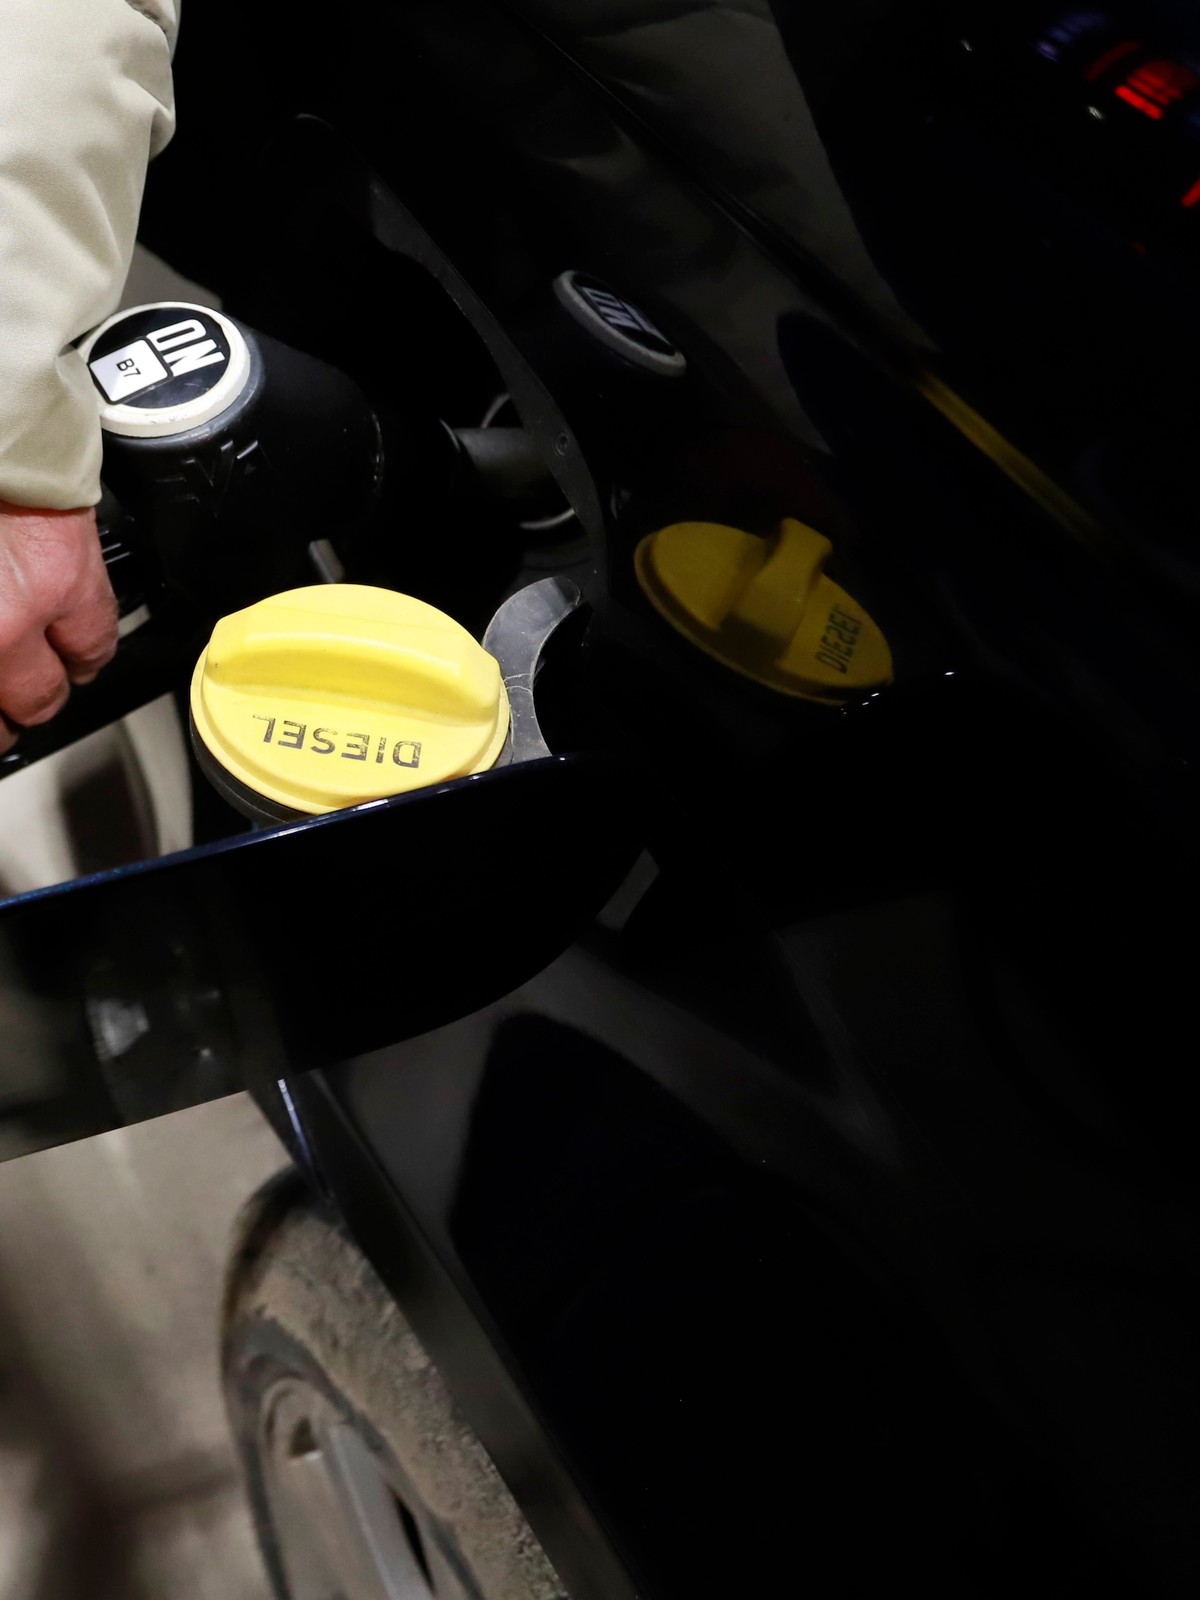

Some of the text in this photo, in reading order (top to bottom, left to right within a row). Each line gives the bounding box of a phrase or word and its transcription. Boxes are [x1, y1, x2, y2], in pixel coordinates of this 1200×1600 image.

[116, 357, 142, 378] B7
[146, 319, 226, 377] ON
[252, 713, 423, 769] DIESEL
